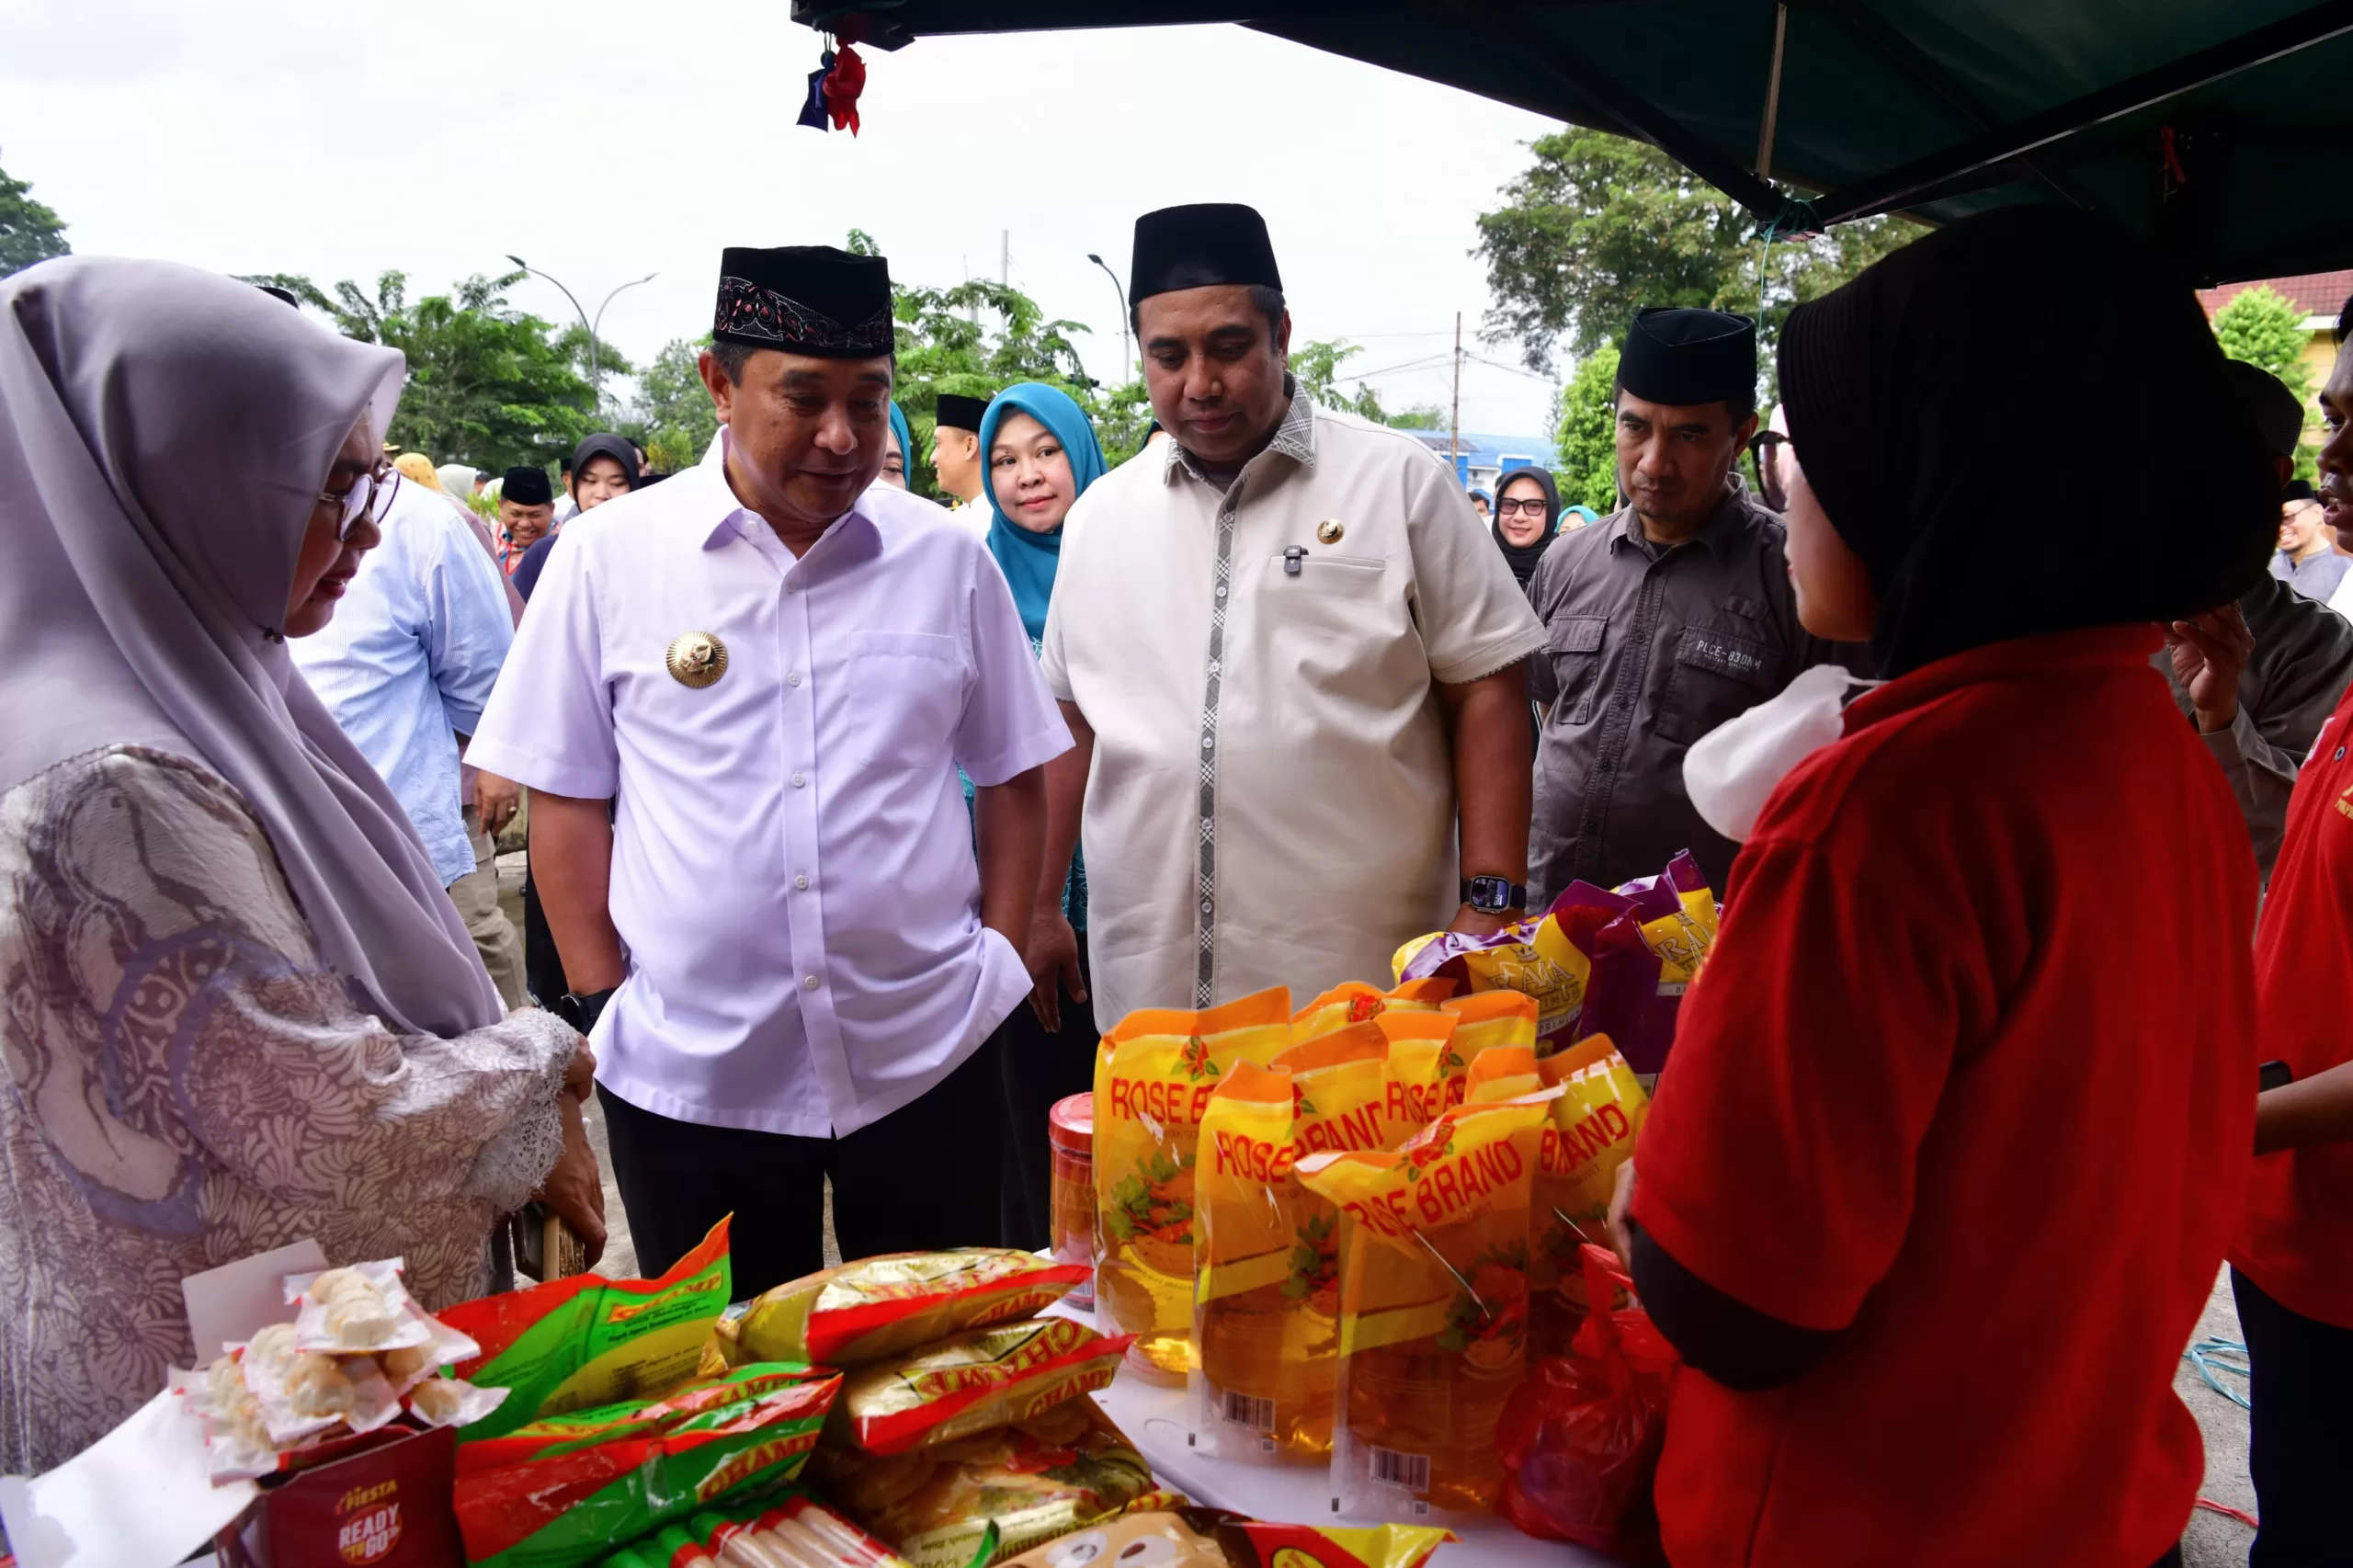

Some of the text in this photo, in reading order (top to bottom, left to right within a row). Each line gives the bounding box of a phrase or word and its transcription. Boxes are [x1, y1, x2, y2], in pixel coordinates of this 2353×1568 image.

[1110, 1076, 1186, 1125] ROSE
[1216, 1131, 1293, 1184] ROSE
[1416, 1140, 1523, 1225] BRAND
[1028, 1369, 1113, 1417] CHAMP
[346, 1479, 397, 1512] FIESTA
[338, 1502, 401, 1551] READY
[365, 1528, 389, 1559] GO
